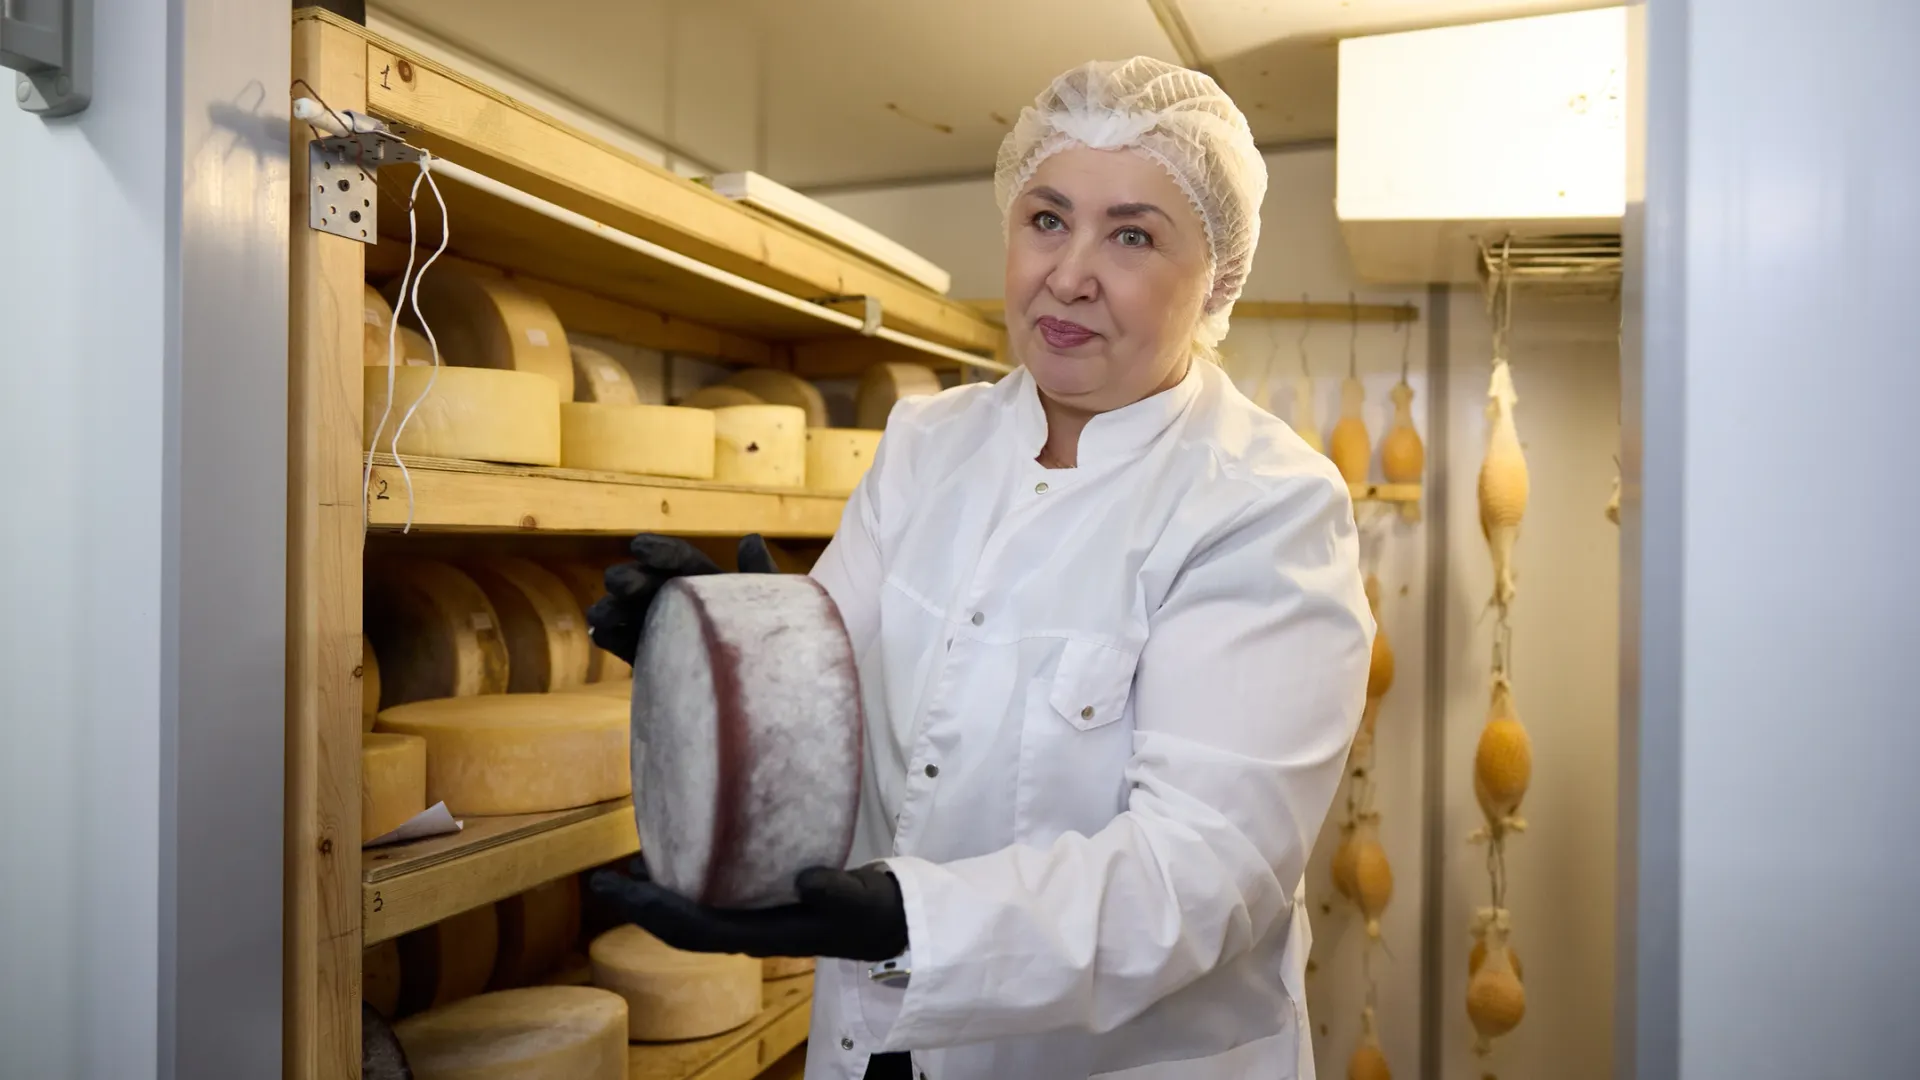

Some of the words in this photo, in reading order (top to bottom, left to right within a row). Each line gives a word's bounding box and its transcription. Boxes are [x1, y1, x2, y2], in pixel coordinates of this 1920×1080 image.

[380, 64, 392, 91] 1
[376, 479, 390, 500] 2
[372, 890, 384, 913] 3
